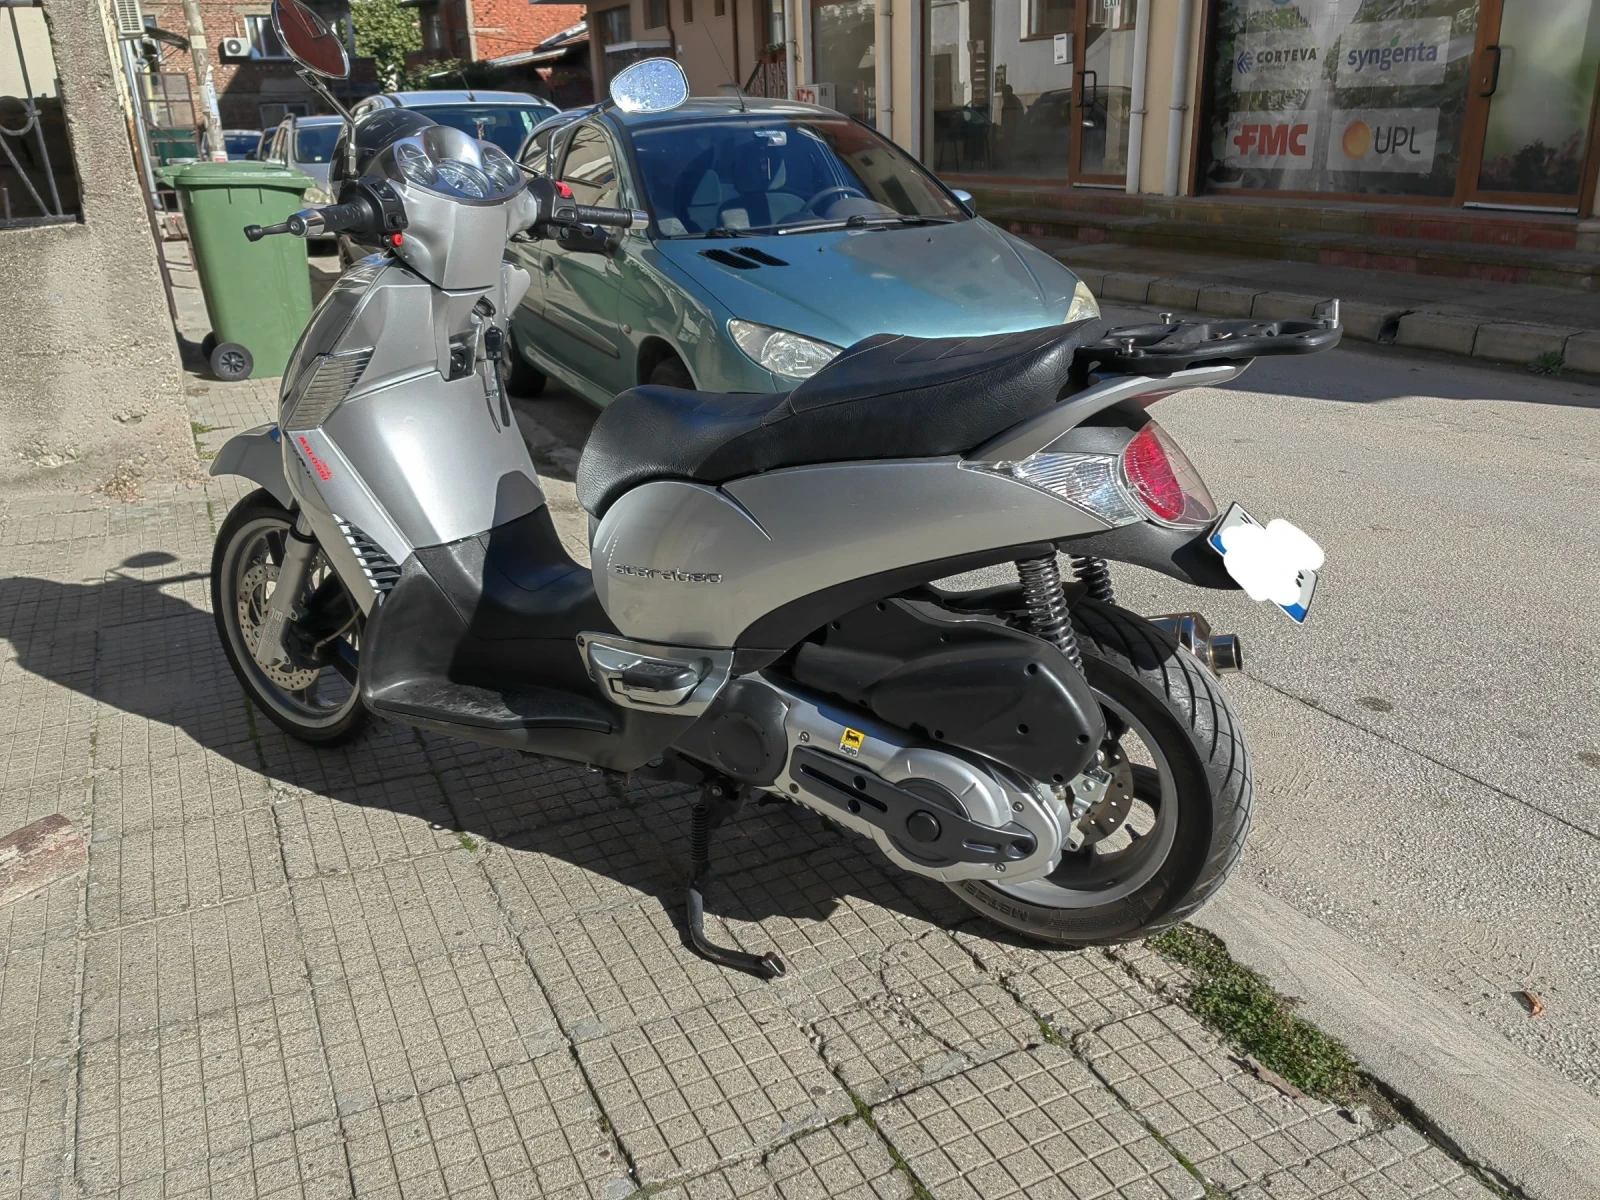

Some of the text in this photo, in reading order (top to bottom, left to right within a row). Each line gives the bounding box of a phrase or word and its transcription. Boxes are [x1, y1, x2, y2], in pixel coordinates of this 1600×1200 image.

[1257, 48, 1317, 63] CORTEVA
[1348, 42, 1438, 72] syngenta
[1233, 124, 1309, 156] FMC
[1374, 126, 1421, 154] UPL
[840, 744, 857, 756] Agip
